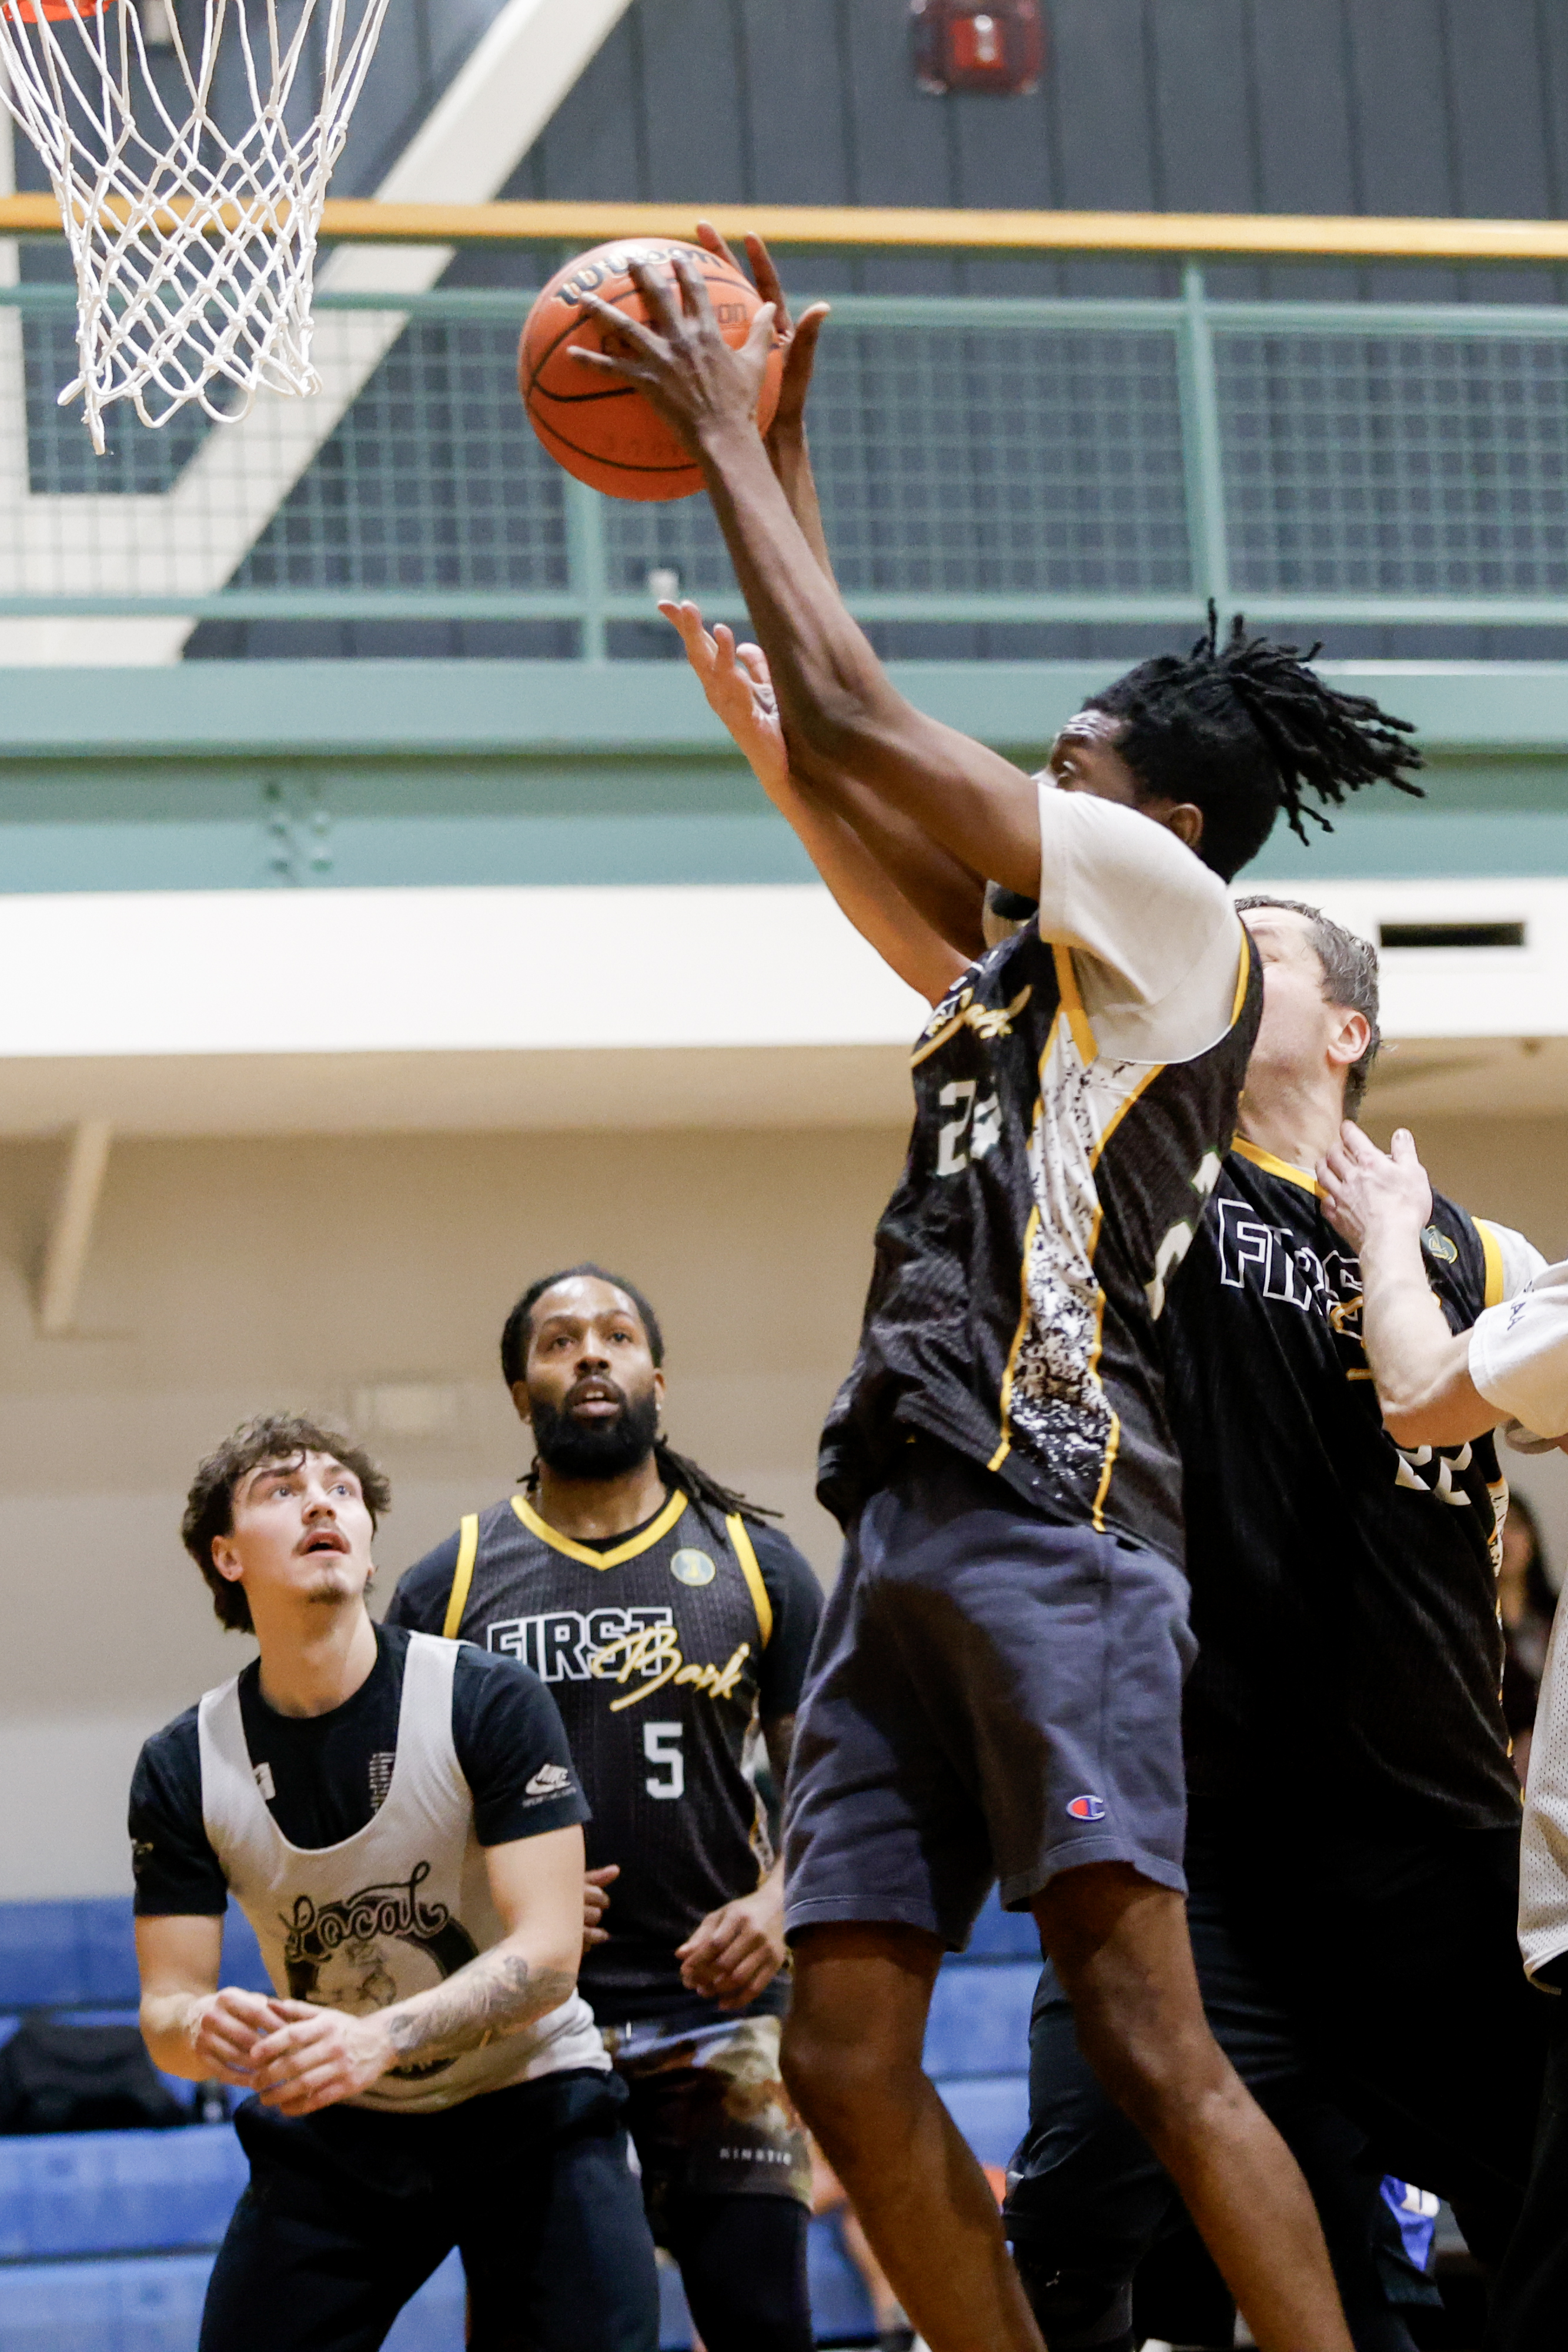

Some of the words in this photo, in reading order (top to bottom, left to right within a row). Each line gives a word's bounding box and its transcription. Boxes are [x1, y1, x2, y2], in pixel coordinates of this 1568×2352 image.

[487, 1607, 674, 1682] FIRST
[590, 1626, 750, 1712] Bank
[644, 1722, 684, 1799] 5
[279, 1860, 450, 1963] Local
